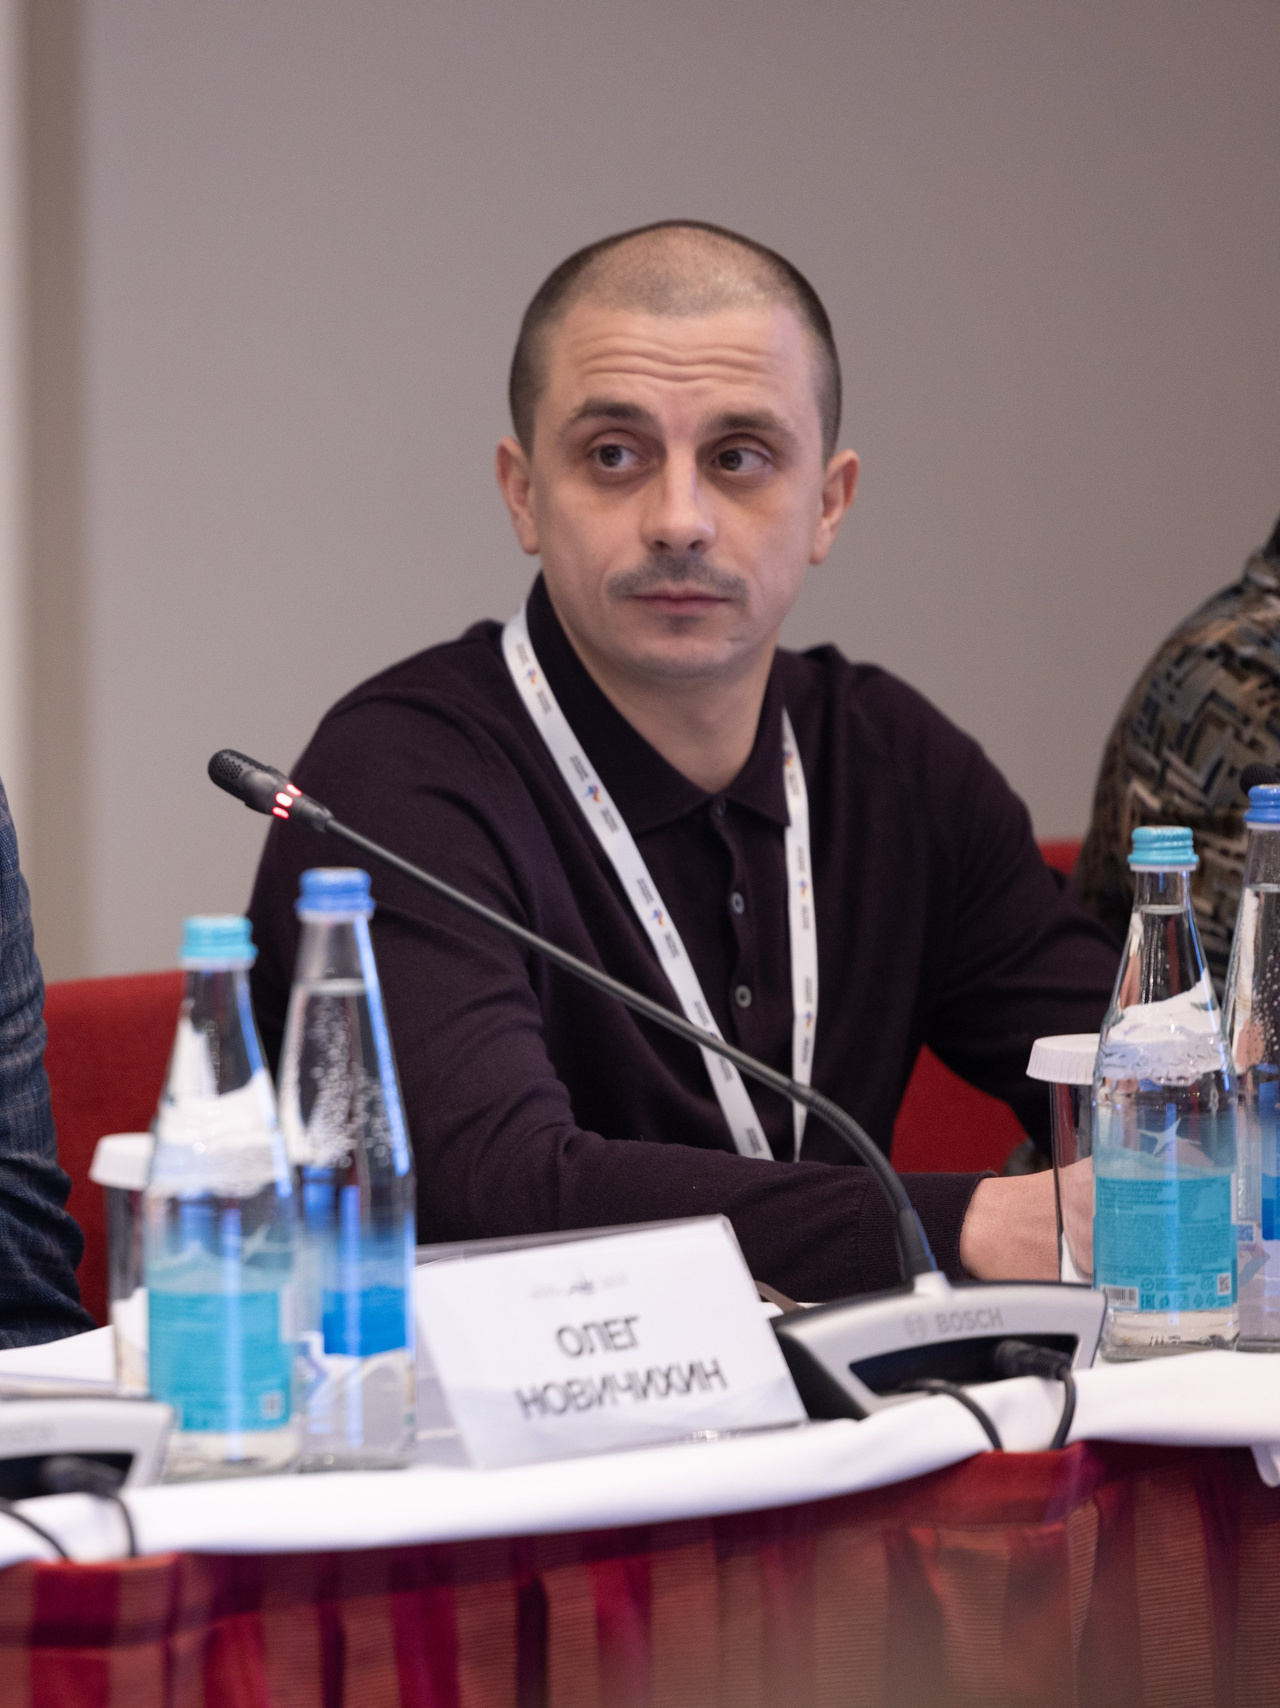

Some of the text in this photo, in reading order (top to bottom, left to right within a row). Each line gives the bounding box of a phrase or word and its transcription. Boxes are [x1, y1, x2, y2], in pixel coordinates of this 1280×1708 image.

[556, 1314, 640, 1358] ОЛЕГ
[934, 1307, 1004, 1333] BOSCH
[515, 1357, 728, 1420] НОВИЧИХИН
